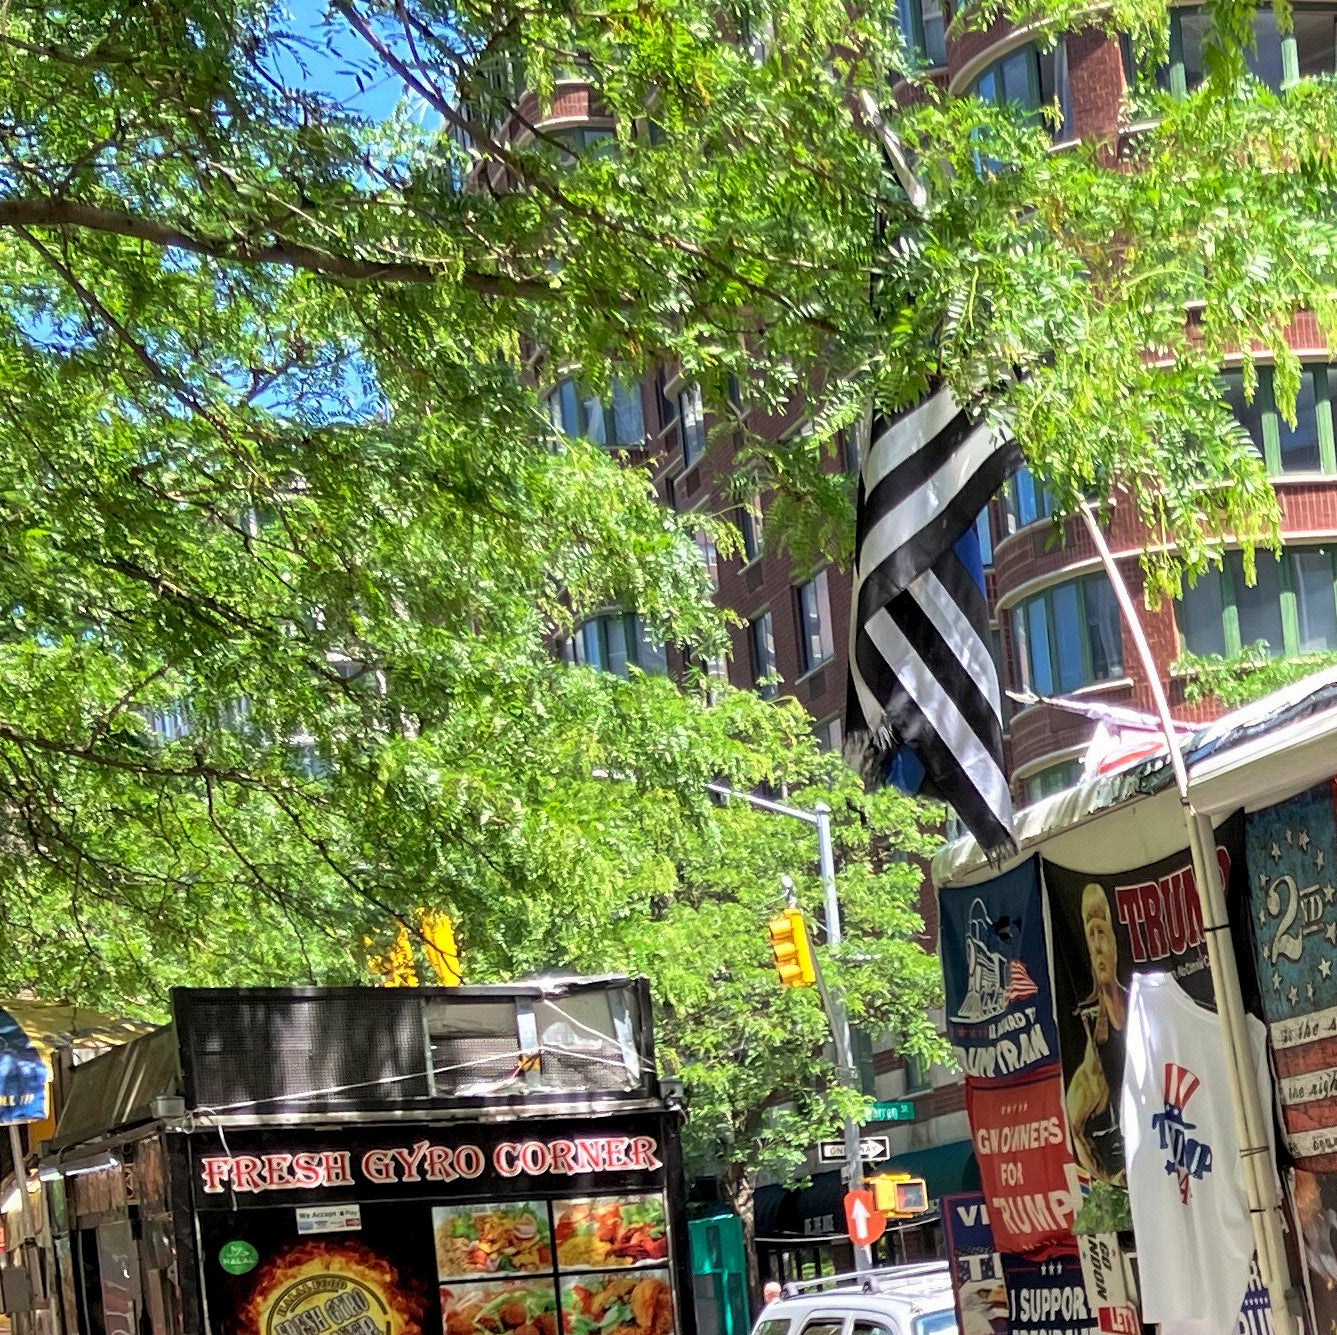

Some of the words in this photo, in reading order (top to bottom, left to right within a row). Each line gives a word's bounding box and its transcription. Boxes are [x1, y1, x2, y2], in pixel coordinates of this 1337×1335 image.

[202, 1150, 355, 1194] FRESH
[361, 1140, 485, 1183] GYRO
[493, 1135, 663, 1177] CORNER
[992, 1190, 1076, 1234] TRUMP
